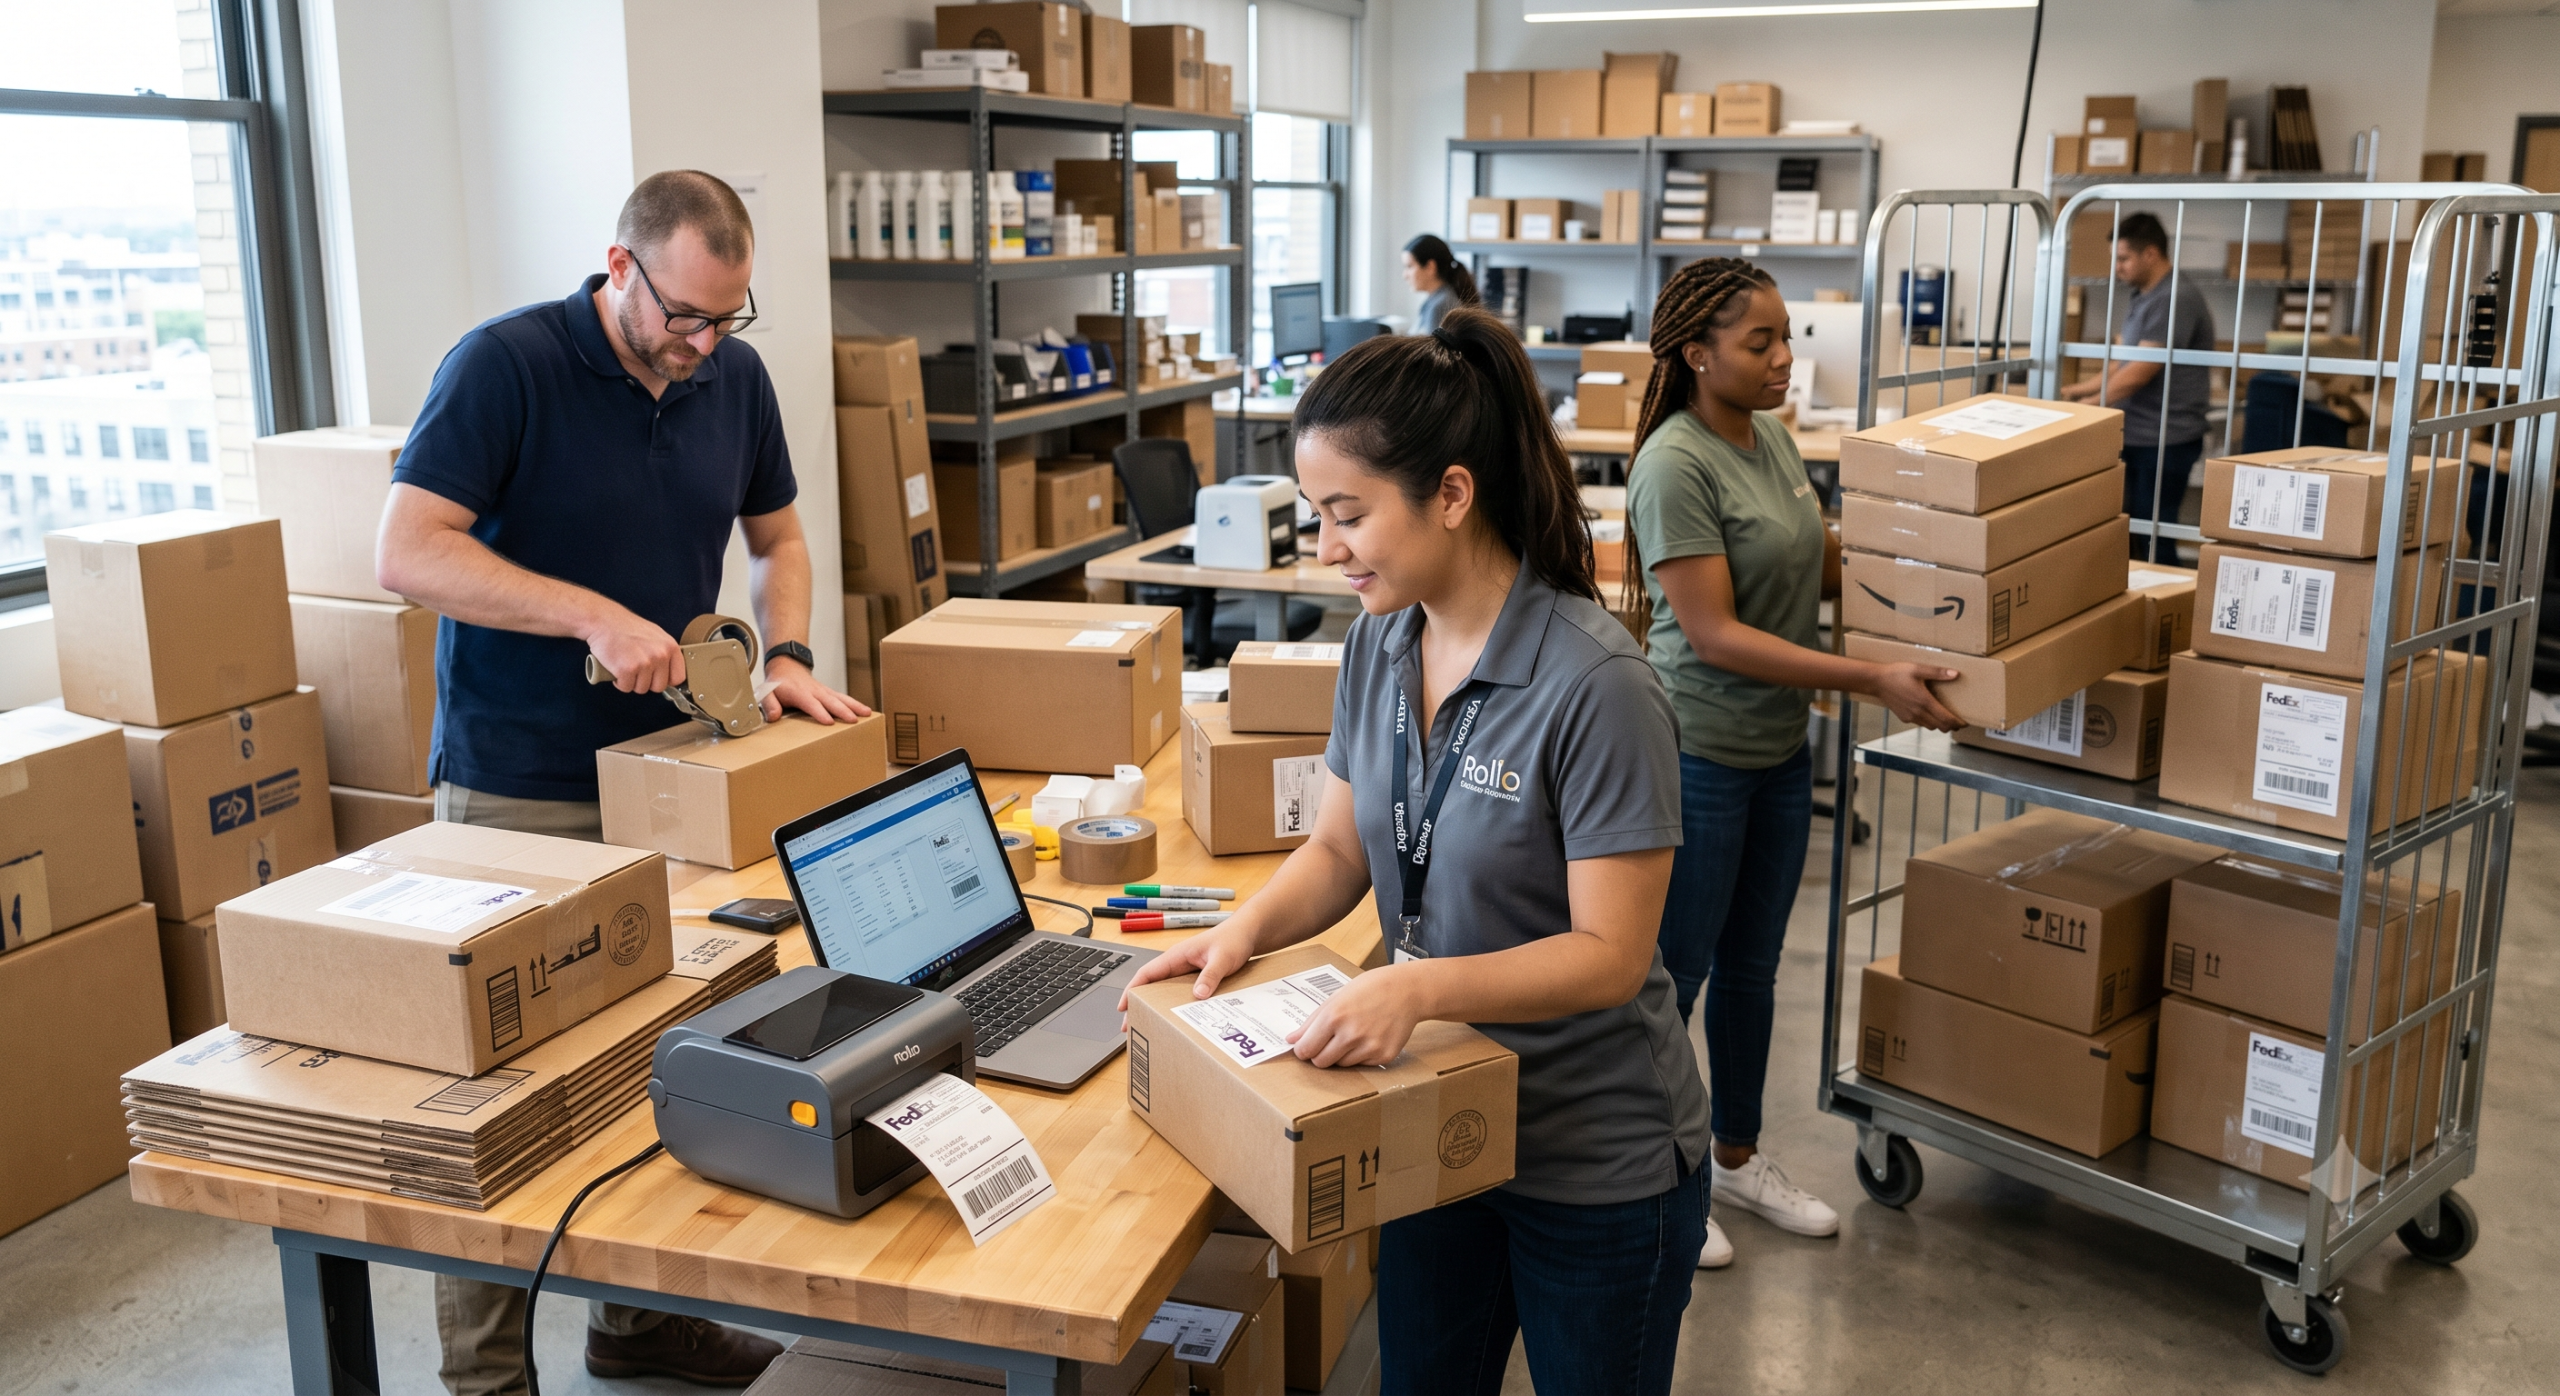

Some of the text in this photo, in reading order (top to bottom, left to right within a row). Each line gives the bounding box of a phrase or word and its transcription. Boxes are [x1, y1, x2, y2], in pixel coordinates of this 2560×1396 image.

[2266, 691, 2300, 708] FedEx
[1462, 755, 1520, 792] Rollo
[2252, 1040, 2293, 1063] FedEx
